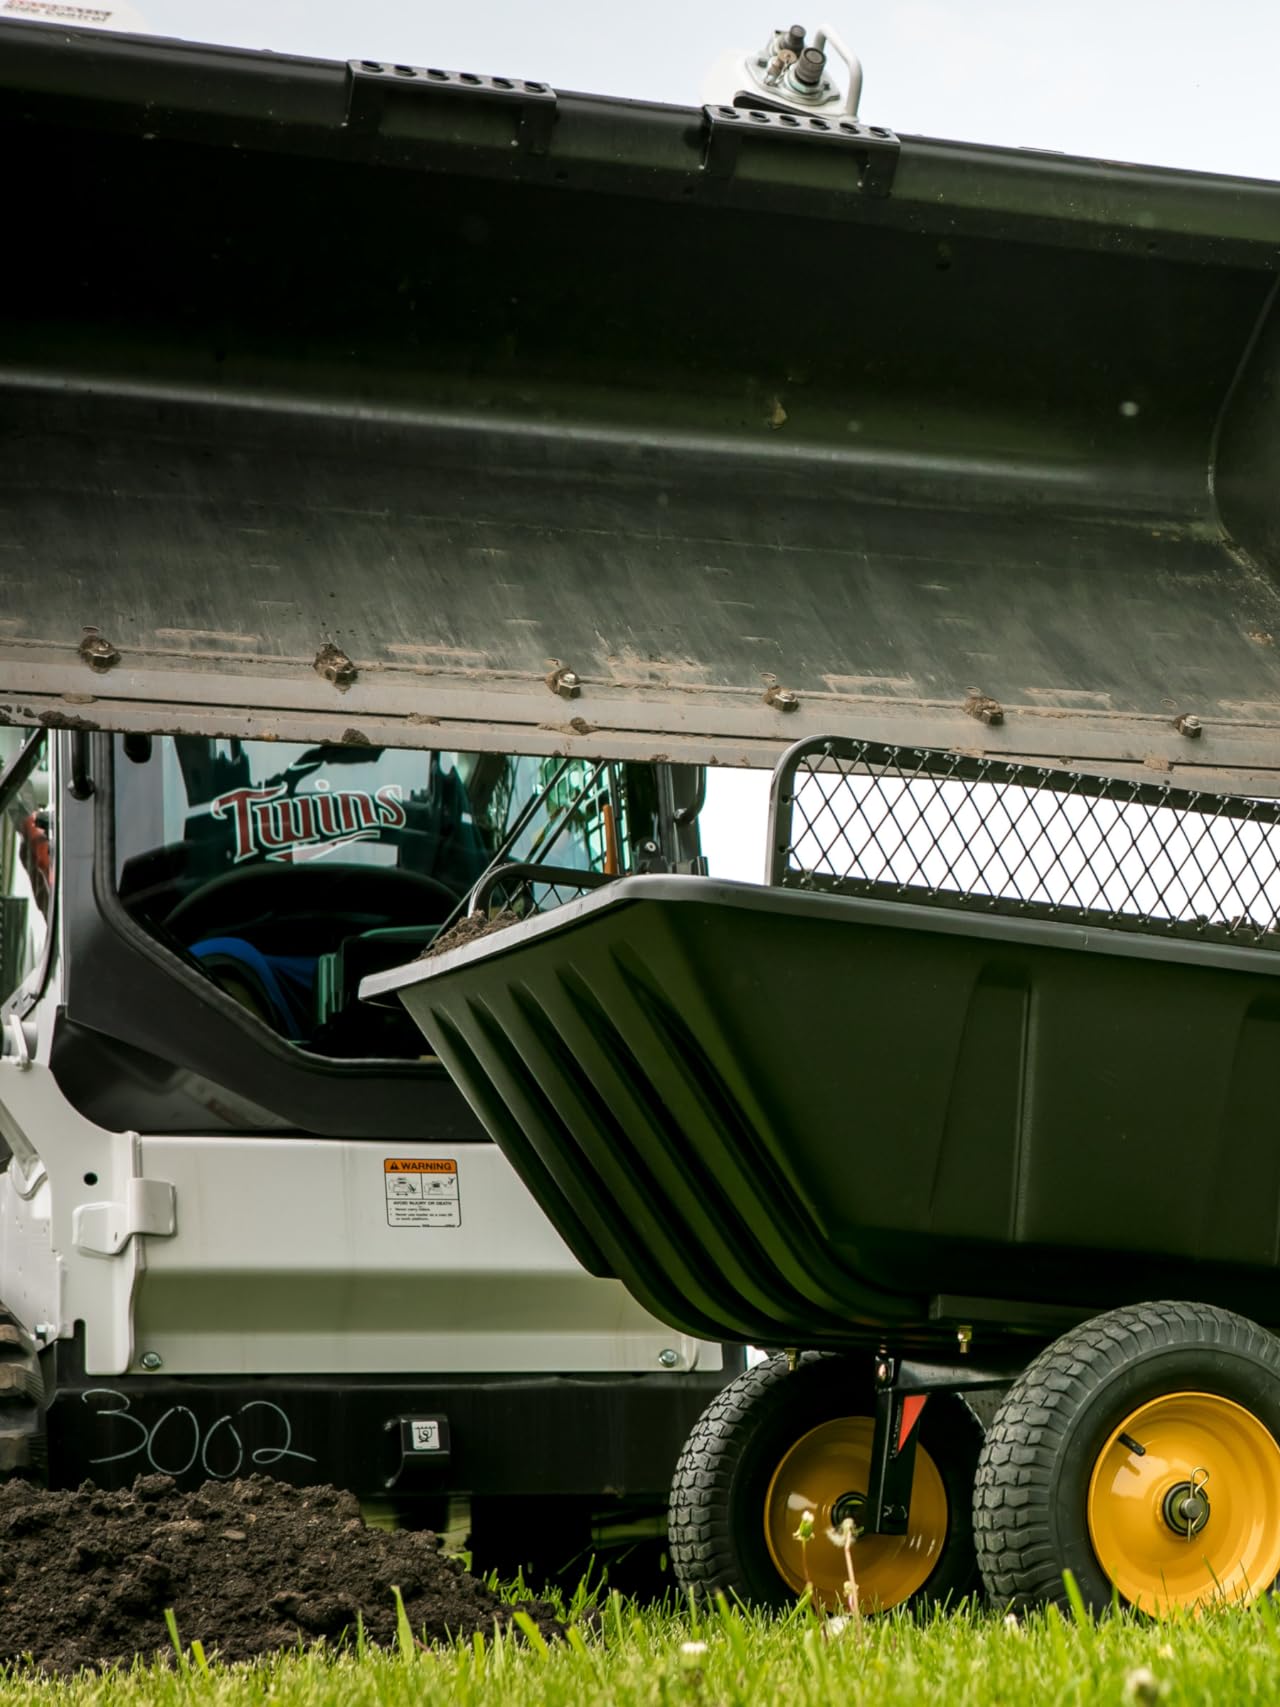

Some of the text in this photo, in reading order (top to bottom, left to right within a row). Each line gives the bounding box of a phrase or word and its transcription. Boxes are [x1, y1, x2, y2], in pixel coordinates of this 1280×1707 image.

[210, 779, 406, 864] Twins
[401, 1162, 451, 1170] WARNING
[81, 1388, 317, 1478] 3002
